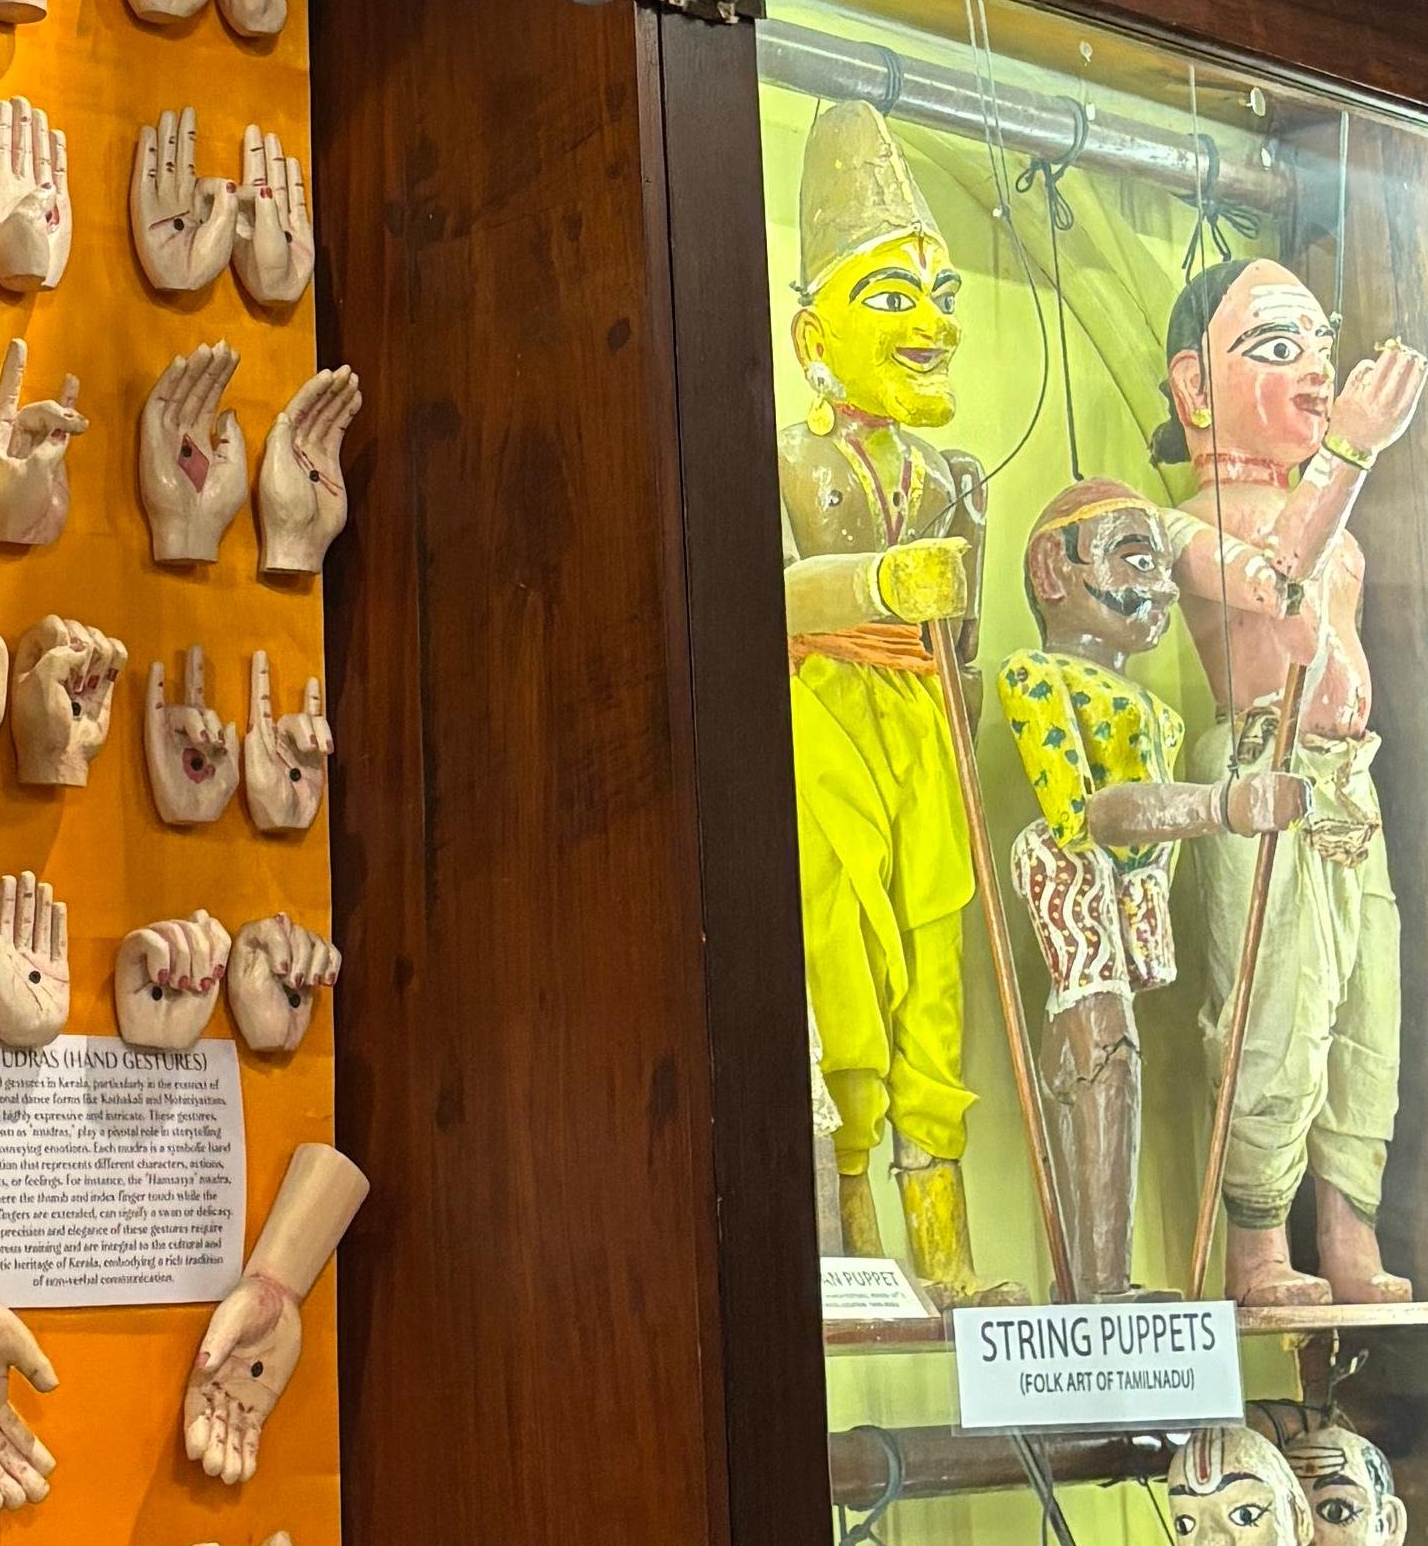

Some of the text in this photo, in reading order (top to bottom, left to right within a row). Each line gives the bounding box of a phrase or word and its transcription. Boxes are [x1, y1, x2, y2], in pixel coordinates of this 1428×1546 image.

[63, 1049, 117, 1070] (HAND
[123, 1051, 207, 1072] GESTURES)
[5, 1078, 45, 1091] gestures
[47, 1077, 56, 1088] in
[59, 1076, 91, 1089] Kerala,
[147, 1077, 155, 1089] in
[158, 1077, 171, 1089] the
[209, 1077, 220, 1090] of
[21, 1093, 50, 1105] dance
[53, 1092, 80, 1104] forms
[83, 1092, 97, 1104] like
[101, 1093, 143, 1105] Kathakali
[146, 1094, 162, 1105] and
[3, 1109, 31, 1123] highly
[34, 1111, 83, 1123] expressive
[86, 1109, 103, 1121] and
[149, 1109, 176, 1122] These
[17, 1128, 27, 1137] as
[78, 1125, 96, 1140] play
[108, 1125, 138, 1138] pivotal
[140, 1126, 159, 1136] role
[161, 1125, 170, 1136] in
[172, 1124, 222, 1140] storytelling
[44, 1142, 91, 1154] emotions.
[94, 1141, 115, 1154] Each
[118, 1142, 147, 1153] mudra
[150, 1142, 157, 1153] is
[167, 1141, 205, 1156] symbolic
[208, 1141, 231, 1153] hand
[20, 1158, 39, 1170] that
[41, 1160, 92, 1172] represents
[94, 1157, 134, 1169] different
[136, 1157, 188, 1169] characters,
[11, 1178, 22, 1187] or
[24, 1174, 63, 1188] feelings.
[67, 1173, 81, 1186] For
[84, 1175, 126, 1186] instance,
[128, 1174, 142, 1186] the
[19, 1192, 35, 1204] the
[37, 1191, 68, 1203] thumb
[71, 1191, 88, 1203] and
[90, 1190, 115, 1202] index
[118, 1190, 146, 1204] finger
[148, 1190, 175, 1202] touch
[177, 1189, 200, 1202] while
[203, 1189, 218, 1201] the
[33, 1210, 48, 1219] are
[51, 1207, 97, 1219] extended,
[100, 1209, 116, 1218] can
[119, 1206, 147, 1221] signify
[158, 1208, 182, 1217] swan
[184, 1208, 194, 1217] or
[0, 1225, 45, 1239] precision
[47, 1225, 65, 1237] and
[67, 1224, 108, 1238] elegance
[110, 1223, 121, 1235] of
[123, 1223, 148, 1235] these
[150, 1223, 188, 1237] gestures
[191, 1223, 223, 1235] require
[24, 1241, 62, 1255] training
[64, 1240, 81, 1252] and
[83, 1241, 99, 1252] are
[101, 1239, 137, 1253] integral
[139, 1240, 149, 1251] to
[152, 1238, 166, 1250] the
[168, 1237, 203, 1250] cultural
[204, 1237, 222, 1249] and
[14, 1257, 54, 1272] heritage
[56, 1256, 67, 1269] of
[69, 1256, 101, 1269] Kerala,
[103, 1254, 156, 1270] embodying
[165, 1254, 183, 1266] rich
[185, 1254, 224, 1266] tradition
[33, 1272, 174, 1287] of non-verbal communication.
[842, 1270, 899, 1287] PUPPET
[980, 1312, 1216, 1362] STRING PUPPETS
[1020, 1367, 1195, 1396] (FOLK ART OF TAMILNADU)
